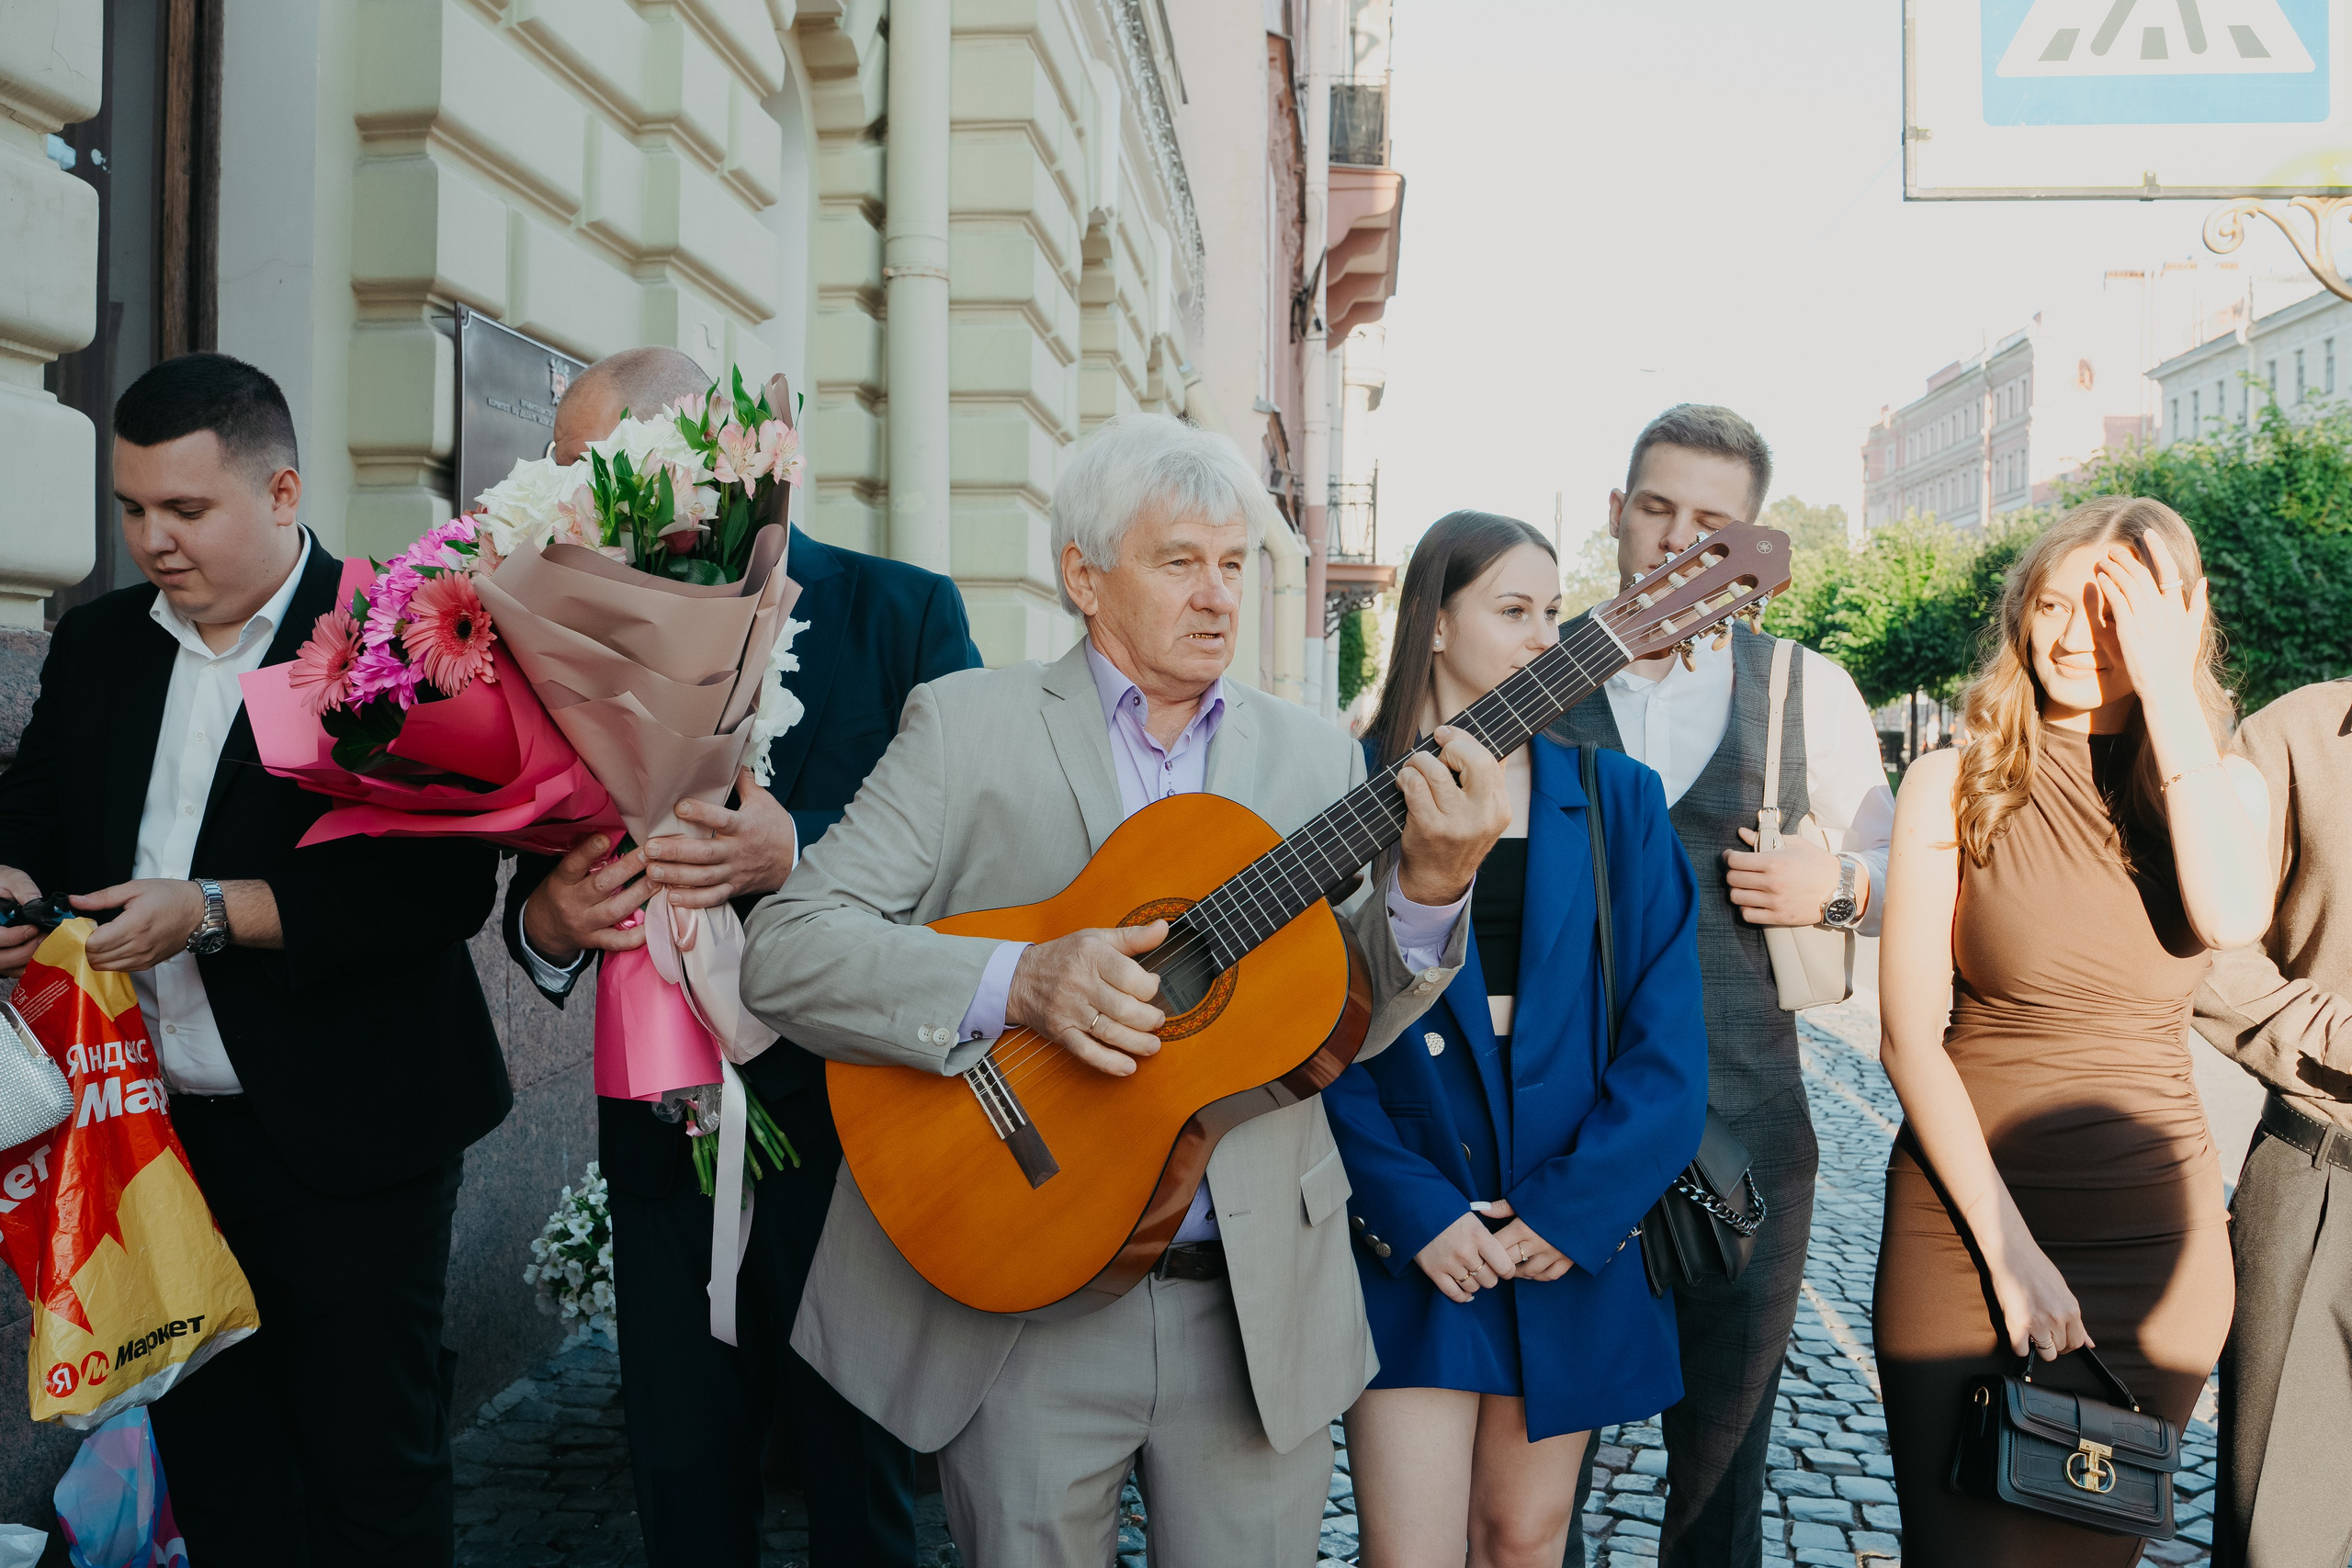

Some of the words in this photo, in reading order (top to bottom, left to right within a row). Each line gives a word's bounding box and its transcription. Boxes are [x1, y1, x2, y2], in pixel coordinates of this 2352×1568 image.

[0, 1144, 51, 1213] ет
[51, 1368, 73, 1393] Я
[114, 1314, 205, 1371] Маркет
